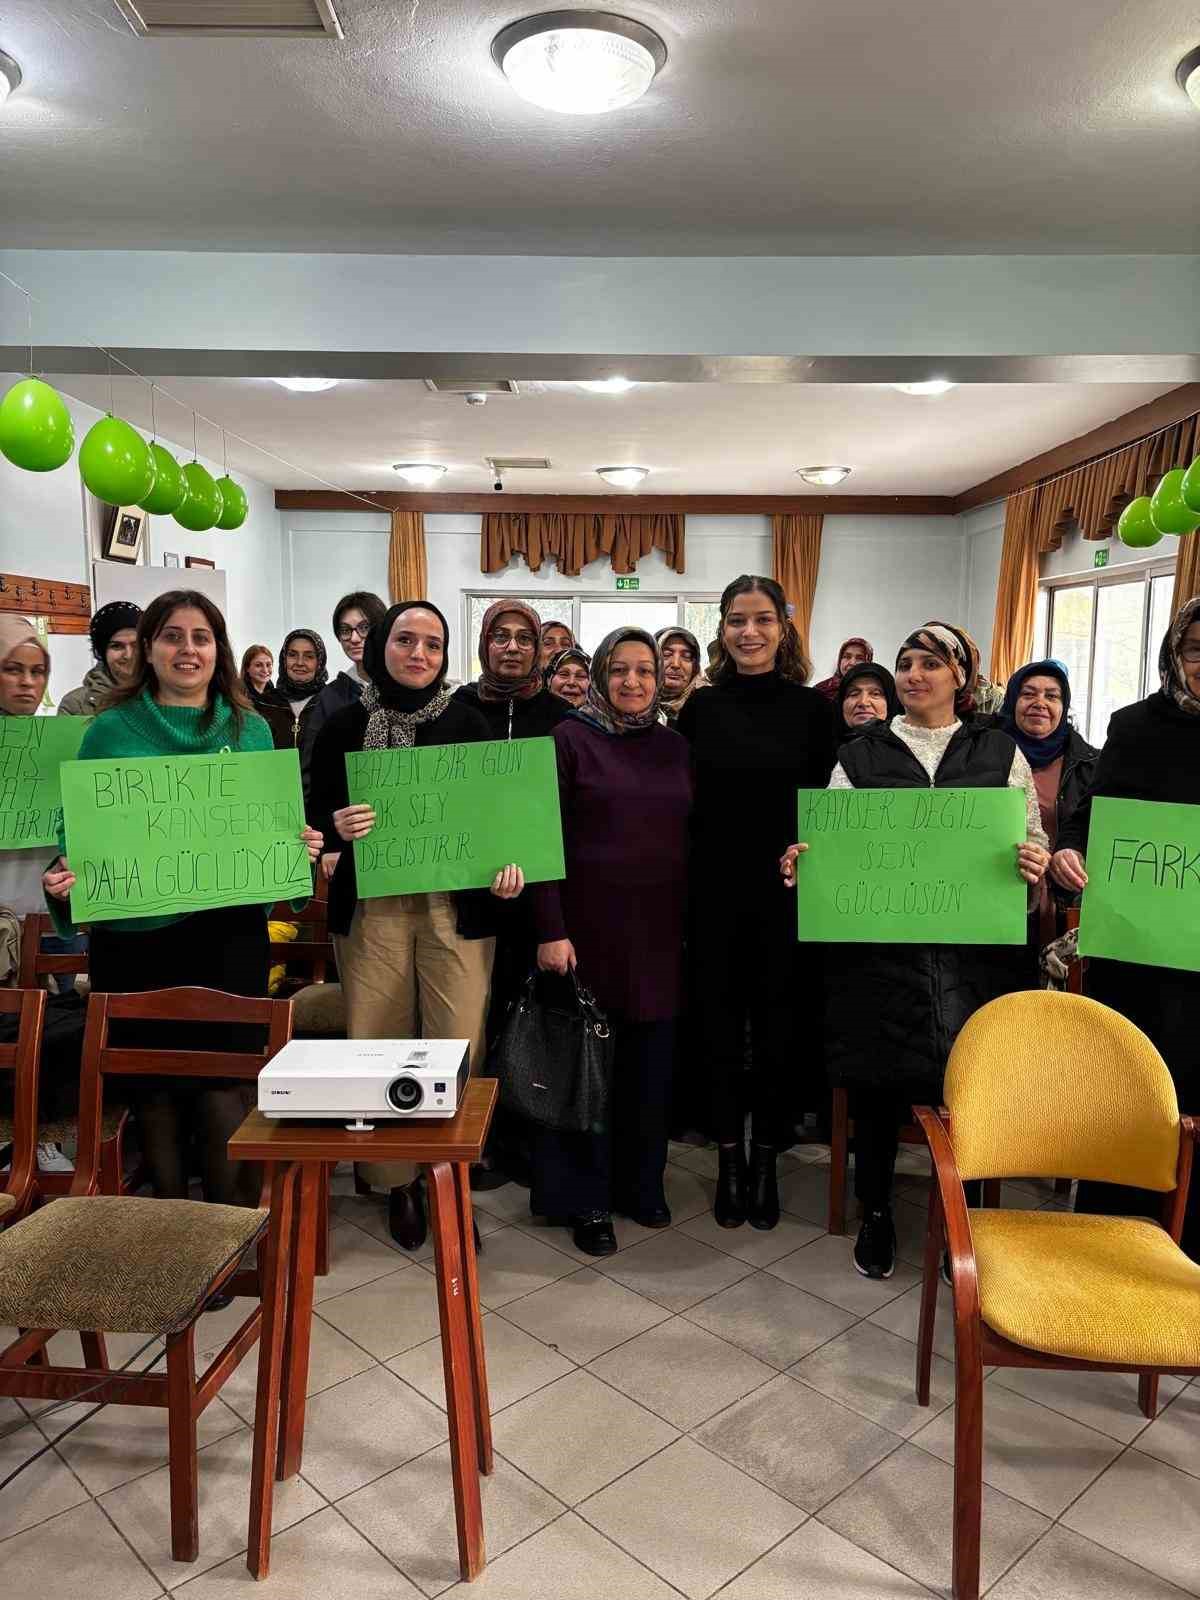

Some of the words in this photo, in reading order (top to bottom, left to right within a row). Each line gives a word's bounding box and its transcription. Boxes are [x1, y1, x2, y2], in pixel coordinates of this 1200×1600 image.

[93, 763, 241, 809] BİRLİKTE
[351, 748, 422, 791] BAZEN
[146, 801, 304, 841] KANSERDEN
[360, 797, 399, 830] OK
[803, 790, 897, 832] KANSER
[858, 840, 927, 871] SEN
[83, 856, 143, 901] DAHA
